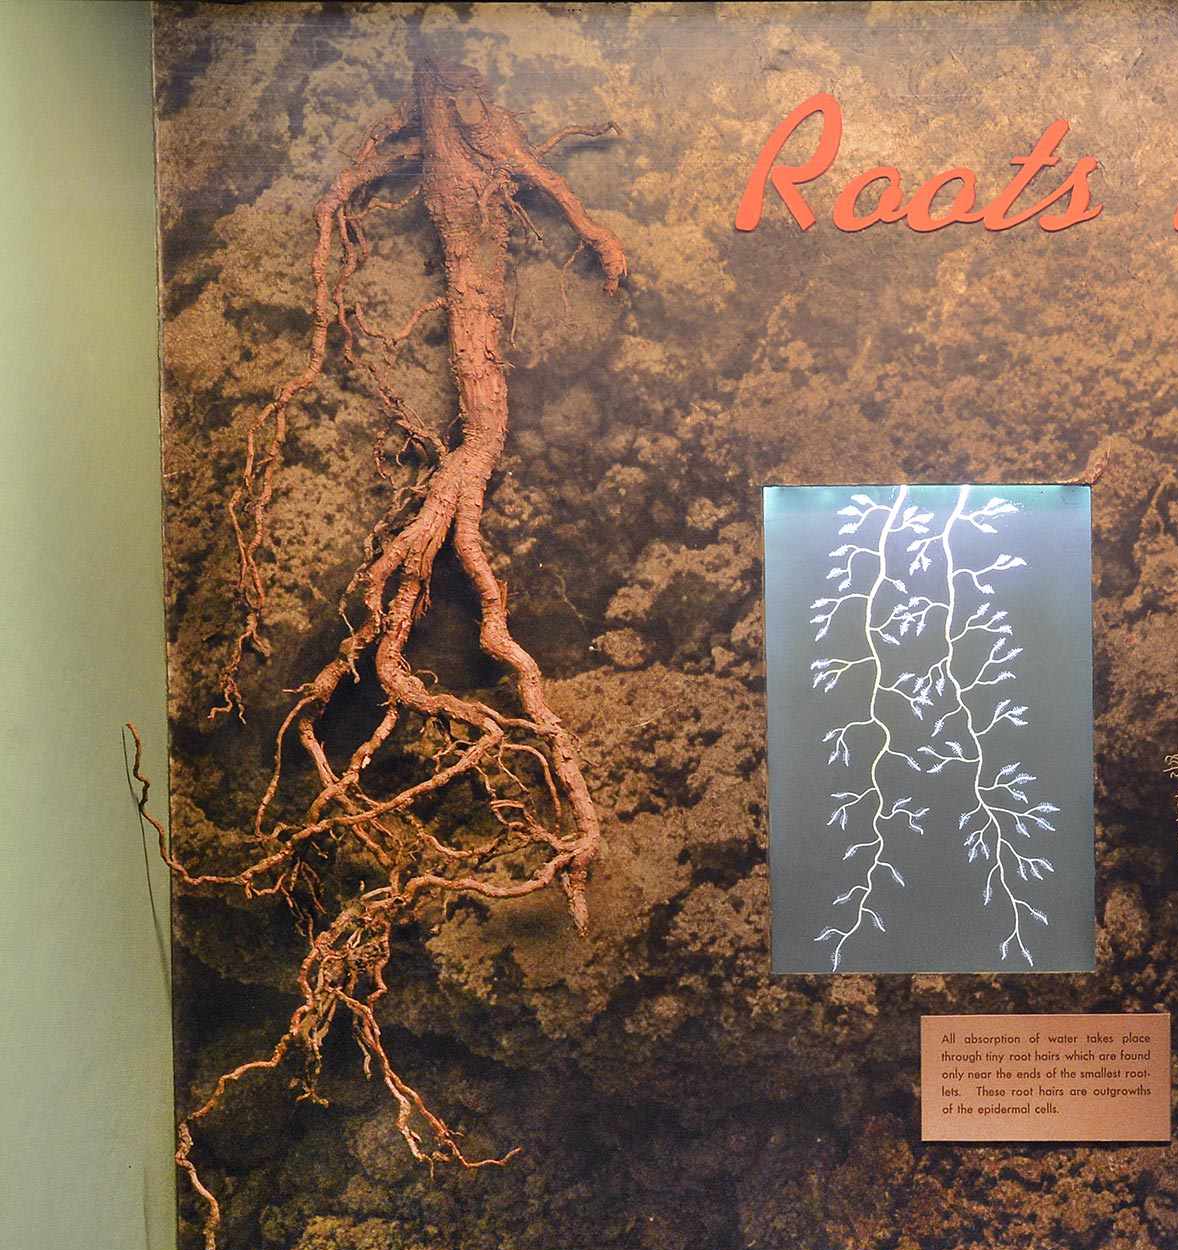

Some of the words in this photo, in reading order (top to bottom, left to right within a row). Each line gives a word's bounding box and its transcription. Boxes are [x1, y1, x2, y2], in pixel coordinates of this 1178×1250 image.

[734, 92, 1104, 231] Roots
[942, 1033, 955, 1043] All
[964, 1033, 1020, 1046] absorption
[1029, 1032, 1040, 1043] of
[1048, 1035, 1078, 1043] water
[1087, 1032, 1113, 1043] takes
[1123, 1032, 1150, 1045] place
[942, 1051, 982, 1063] through
[986, 1053, 1004, 1063] tiny
[1010, 1053, 1031, 1061] root
[1035, 1050, 1060, 1061] hairs
[1065, 1050, 1094, 1060] which
[1121, 1050, 1150, 1060] found
[942, 1068, 964, 1081] only
[997, 1068, 1012, 1079] the
[1017, 1068, 1041, 1078] ends
[1046, 1068, 1056, 1078] of
[1061, 1068, 1076, 1078] the
[1080, 1067, 1120, 1078] smallest
[1126, 1070, 1149, 1078] root-
[942, 1086, 961, 1096] lets.
[976, 1086, 1005, 1096] These
[1012, 1088, 1033, 1096] root
[1039, 1085, 1064, 1096] hairs
[1093, 1085, 1151, 1097] outgrowths
[942, 1103, 953, 1114] of
[958, 1103, 973, 1114] the
[978, 1103, 1030, 1116] epidermal
[1035, 1103, 1059, 1114] cells.
